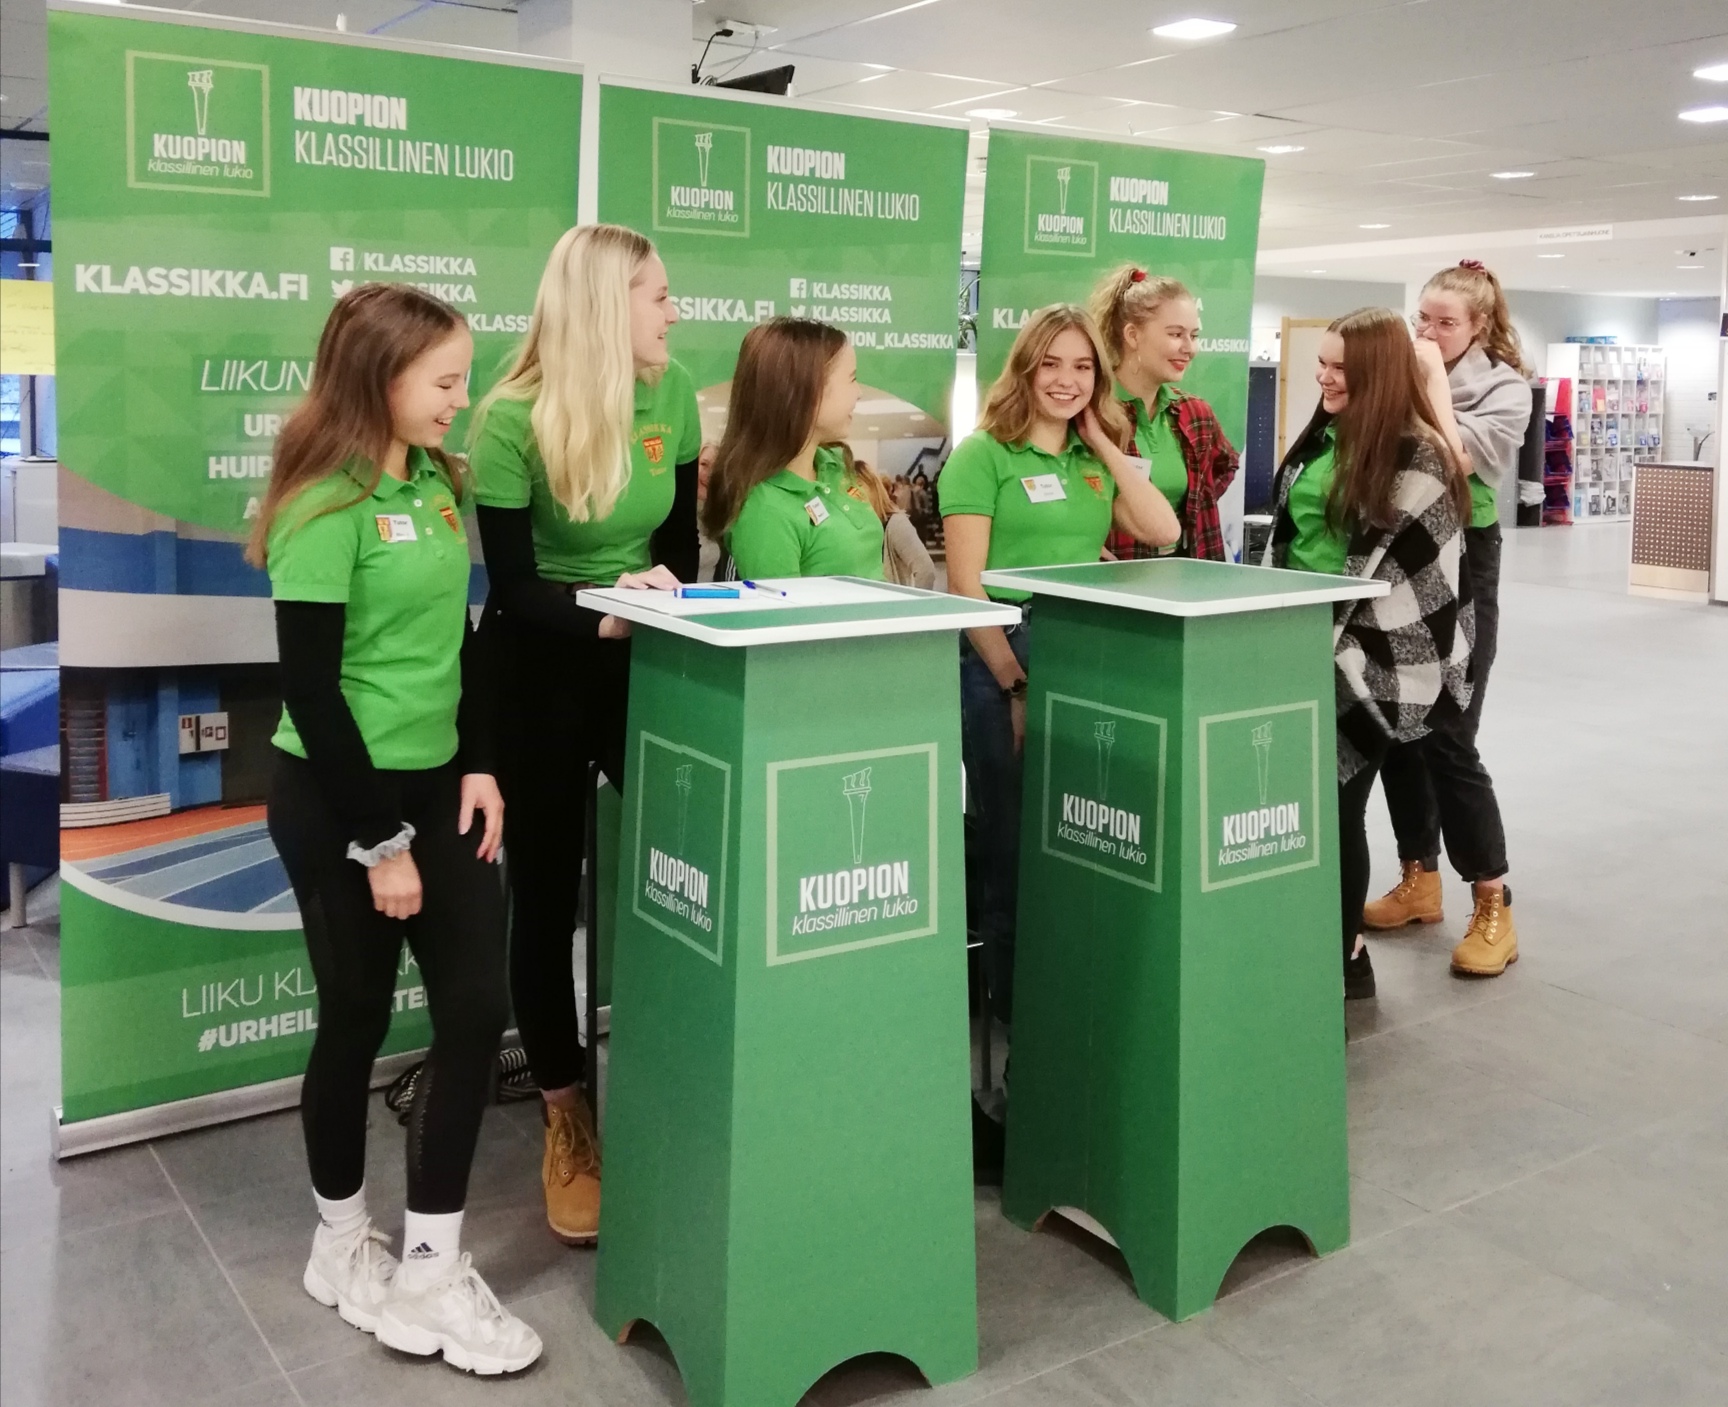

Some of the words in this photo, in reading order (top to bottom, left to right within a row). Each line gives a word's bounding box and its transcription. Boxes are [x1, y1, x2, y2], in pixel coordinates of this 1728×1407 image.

[294, 87, 407, 131] KUOPION
[153, 133, 246, 164] KUOPION
[294, 131, 449, 176] KLASSILLINEN
[455, 145, 514, 182] LUKIO
[767, 145, 845, 180] KUOPION
[147, 159, 220, 176] klassillinen
[223, 163, 254, 179] lukio
[671, 186, 733, 211] KUOPION
[767, 181, 874, 218] KLASSILLINEN
[877, 192, 920, 221] LUKIO
[1109, 176, 1169, 206] KUOPION
[666, 206, 715, 221] klassillinen
[717, 210, 739, 223] lukio
[1038, 213, 1084, 235] KUOPION
[1109, 208, 1190, 237] KLASSILLINEN
[1192, 216, 1226, 241] LUKIO
[75, 264, 309, 301] KLASSIKKA.FI
[200, 360, 313, 391] LIIKUN
[208, 456, 273, 479] HUIP
[1063, 792, 1141, 846] KUOPION
[1223, 802, 1300, 847] KUOPION
[1057, 821, 1116, 855] klassillinen
[1119, 841, 1147, 866] lukio
[1218, 840, 1278, 866] klassillinen
[1280, 834, 1306, 853] lukio
[650, 847, 709, 909] KUOPION
[799, 860, 910, 914] KUOPION
[644, 878, 689, 920] klassillinen
[690, 900, 713, 933] lukio
[792, 904, 877, 936] klassillinen
[882, 895, 919, 920] lukio
[182, 974, 263, 1018] LIIKU
[198, 1007, 319, 1053] #URHEIL
